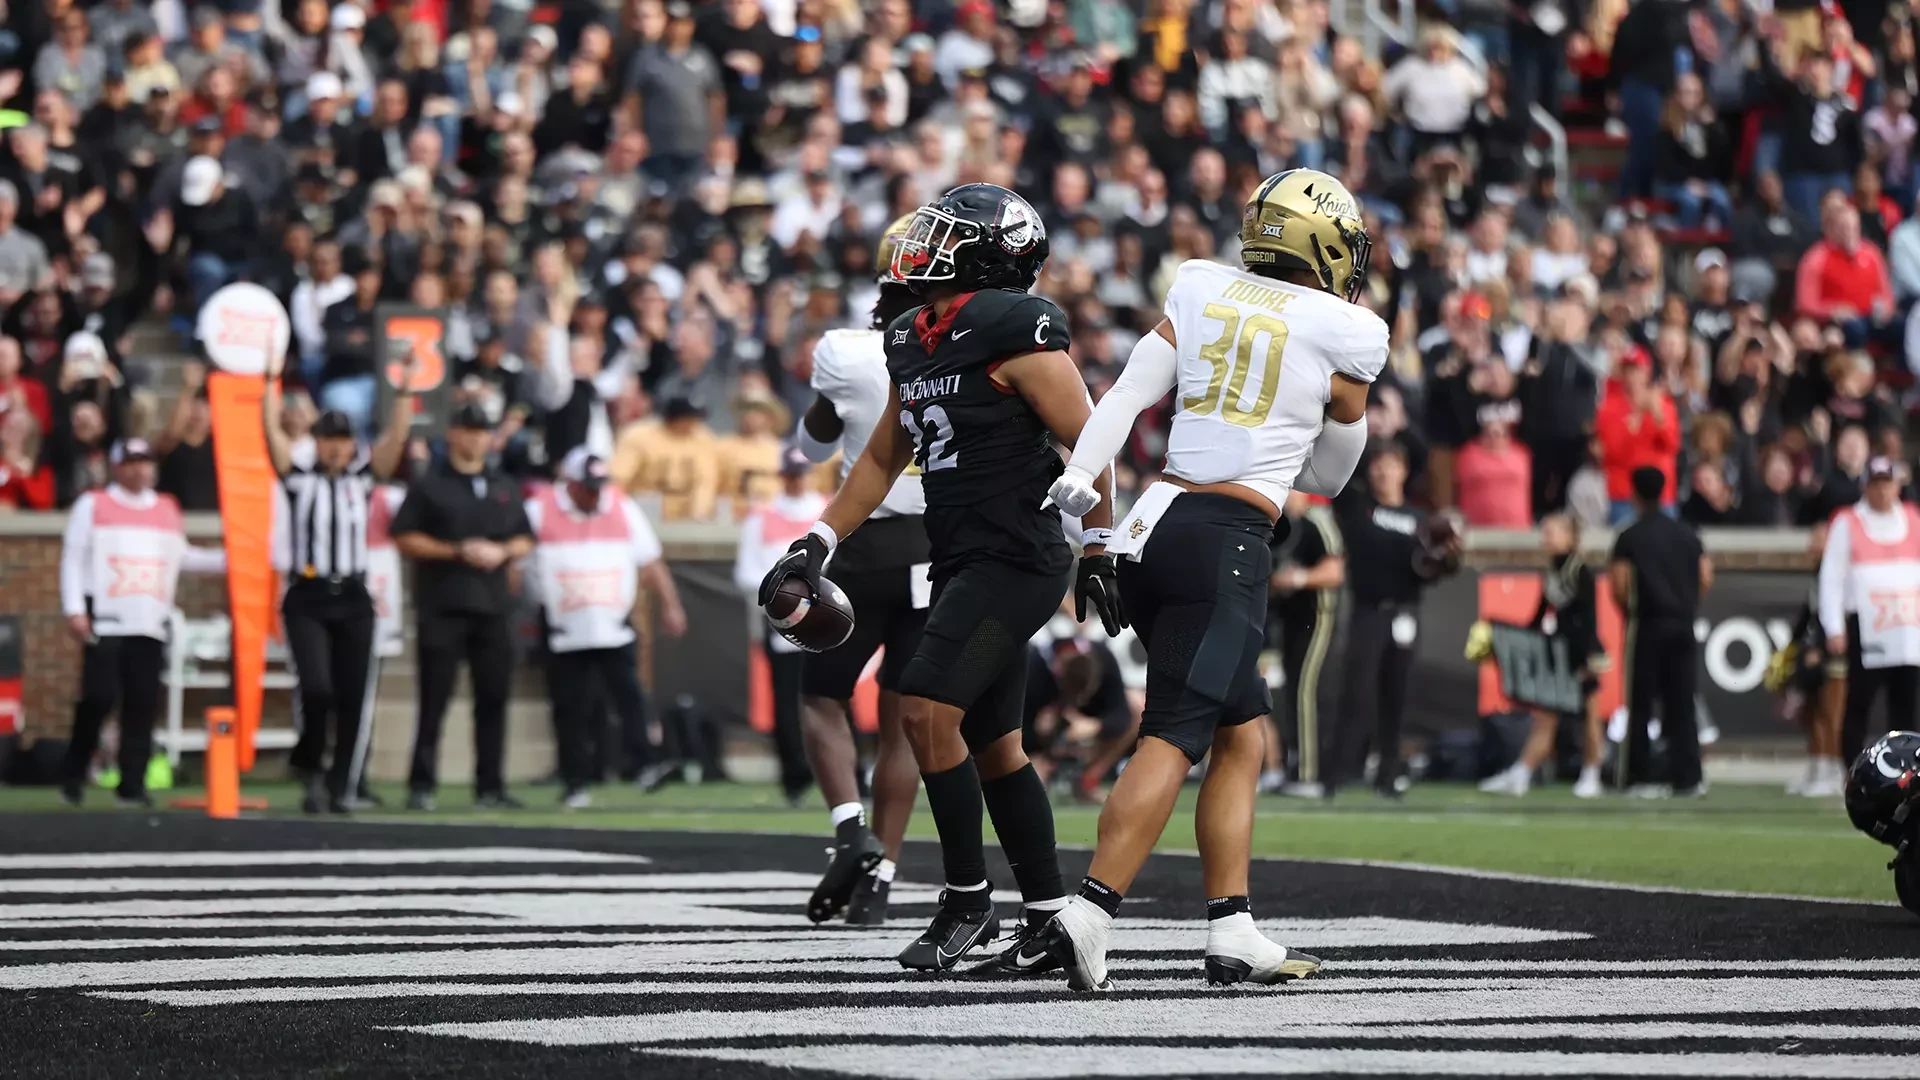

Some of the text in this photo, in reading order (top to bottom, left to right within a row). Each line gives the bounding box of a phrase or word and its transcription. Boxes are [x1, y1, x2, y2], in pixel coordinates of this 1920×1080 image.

[1311, 192, 1359, 220] Knigh
[1261, 223, 1283, 238] XII
[1221, 279, 1299, 313] MOORE
[1034, 319, 1050, 345] C
[385, 316, 446, 391] 3
[1183, 302, 1289, 428] 30
[899, 375, 962, 402] CINCINNATI
[1088, 880, 1109, 895] GRIP
[1207, 897, 1229, 906] GRIP
